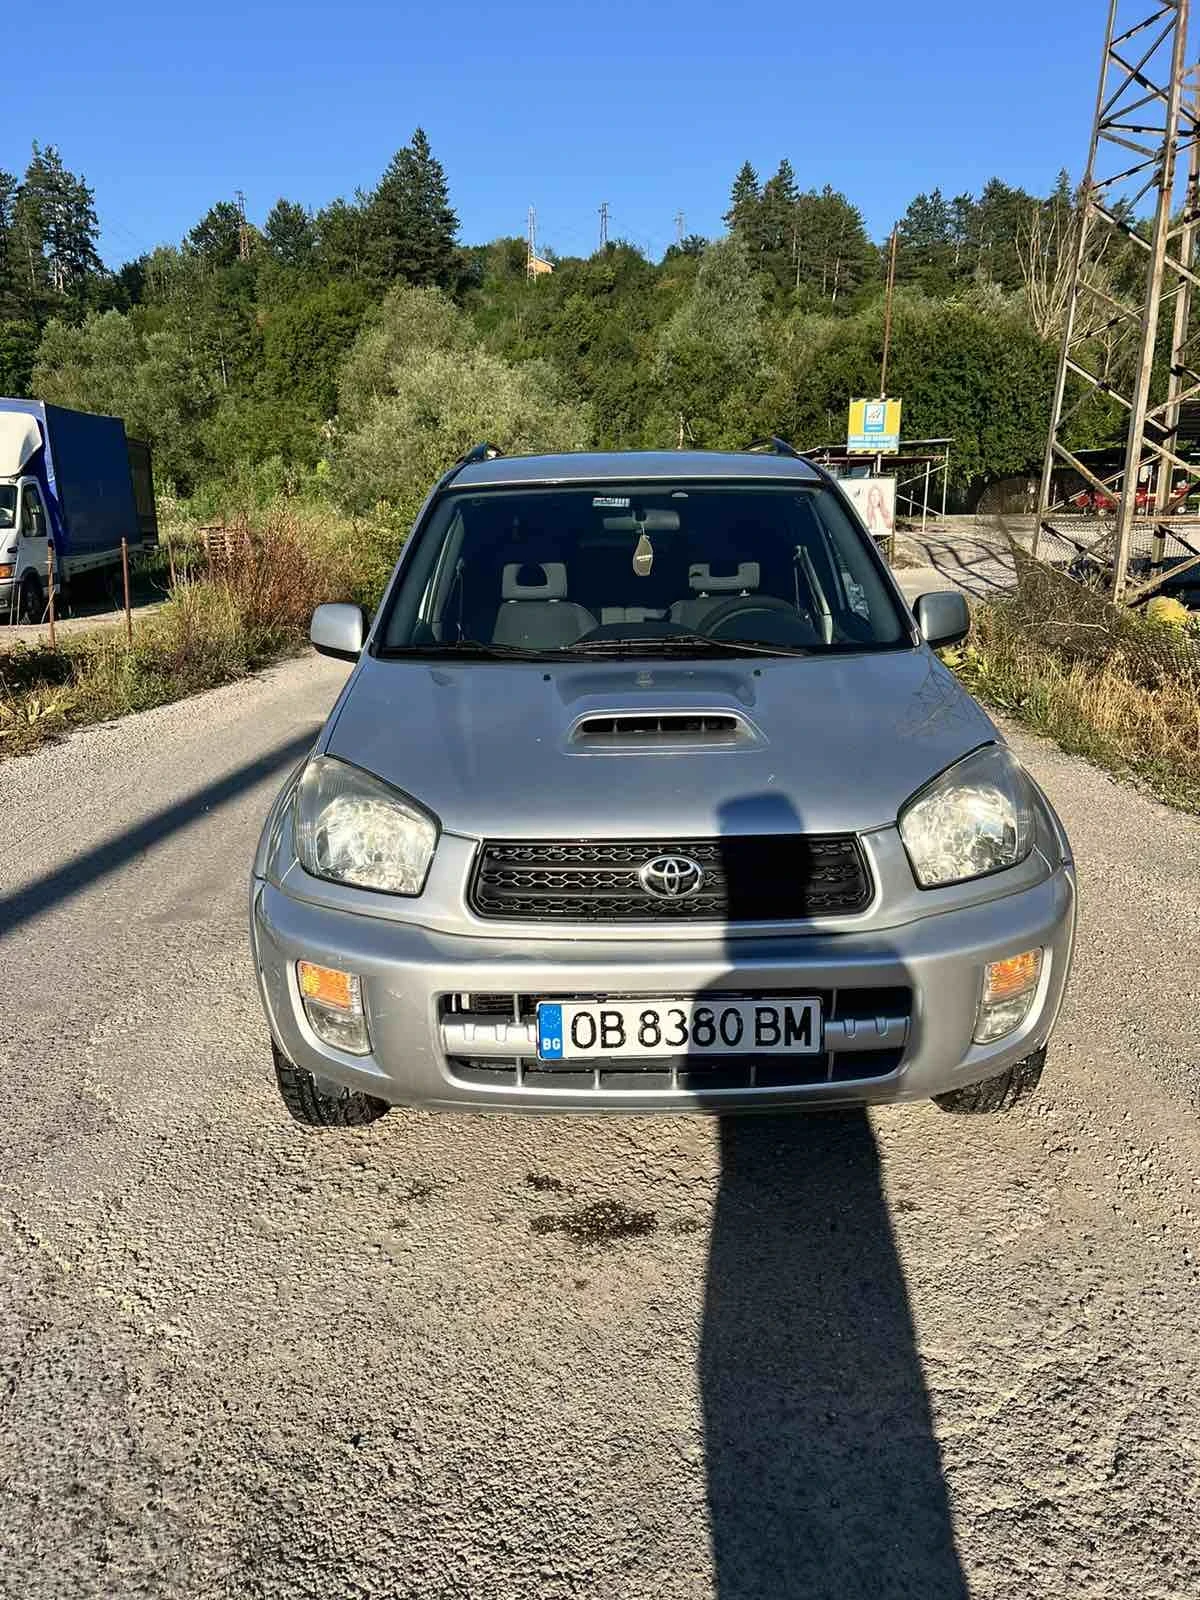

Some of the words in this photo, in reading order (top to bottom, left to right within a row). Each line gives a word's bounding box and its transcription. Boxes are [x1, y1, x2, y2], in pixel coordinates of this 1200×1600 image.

[571, 1011, 626, 1049] OB
[638, 1007, 743, 1048] 8380
[755, 1006, 811, 1047] BM
[542, 1038, 560, 1050] BG
